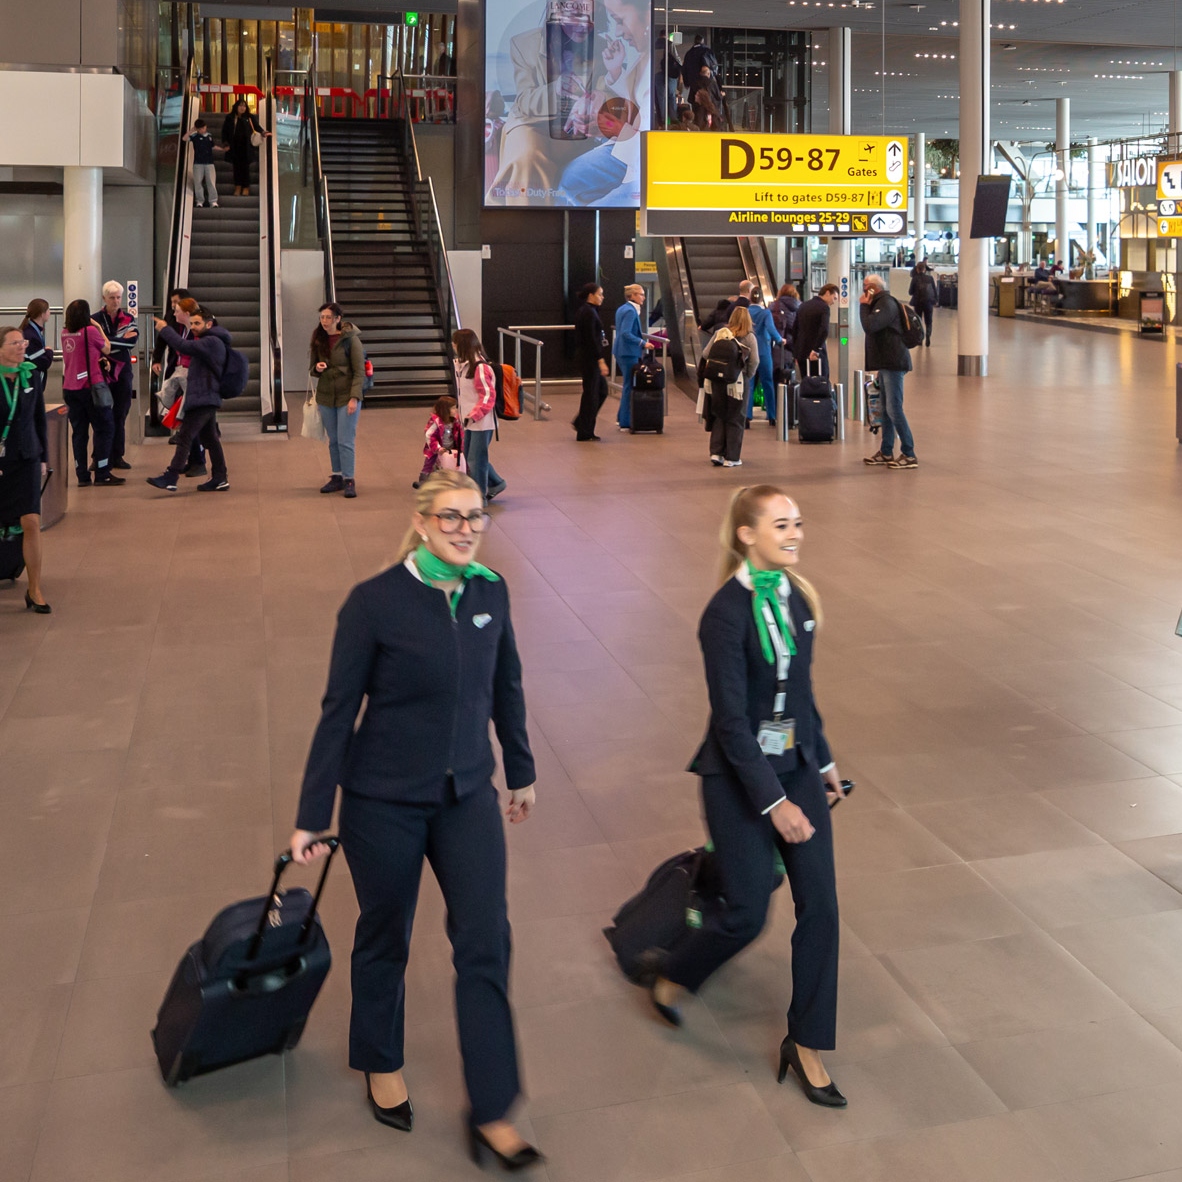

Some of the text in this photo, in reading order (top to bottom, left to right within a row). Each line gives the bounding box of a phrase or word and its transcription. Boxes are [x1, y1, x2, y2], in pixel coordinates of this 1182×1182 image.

[847, 167, 878, 177] Gates
[1117, 156, 1157, 187] SALON
[754, 192, 865, 205] Lift to gates D59-87
[728, 212, 850, 226] Airline lounges 25-29
